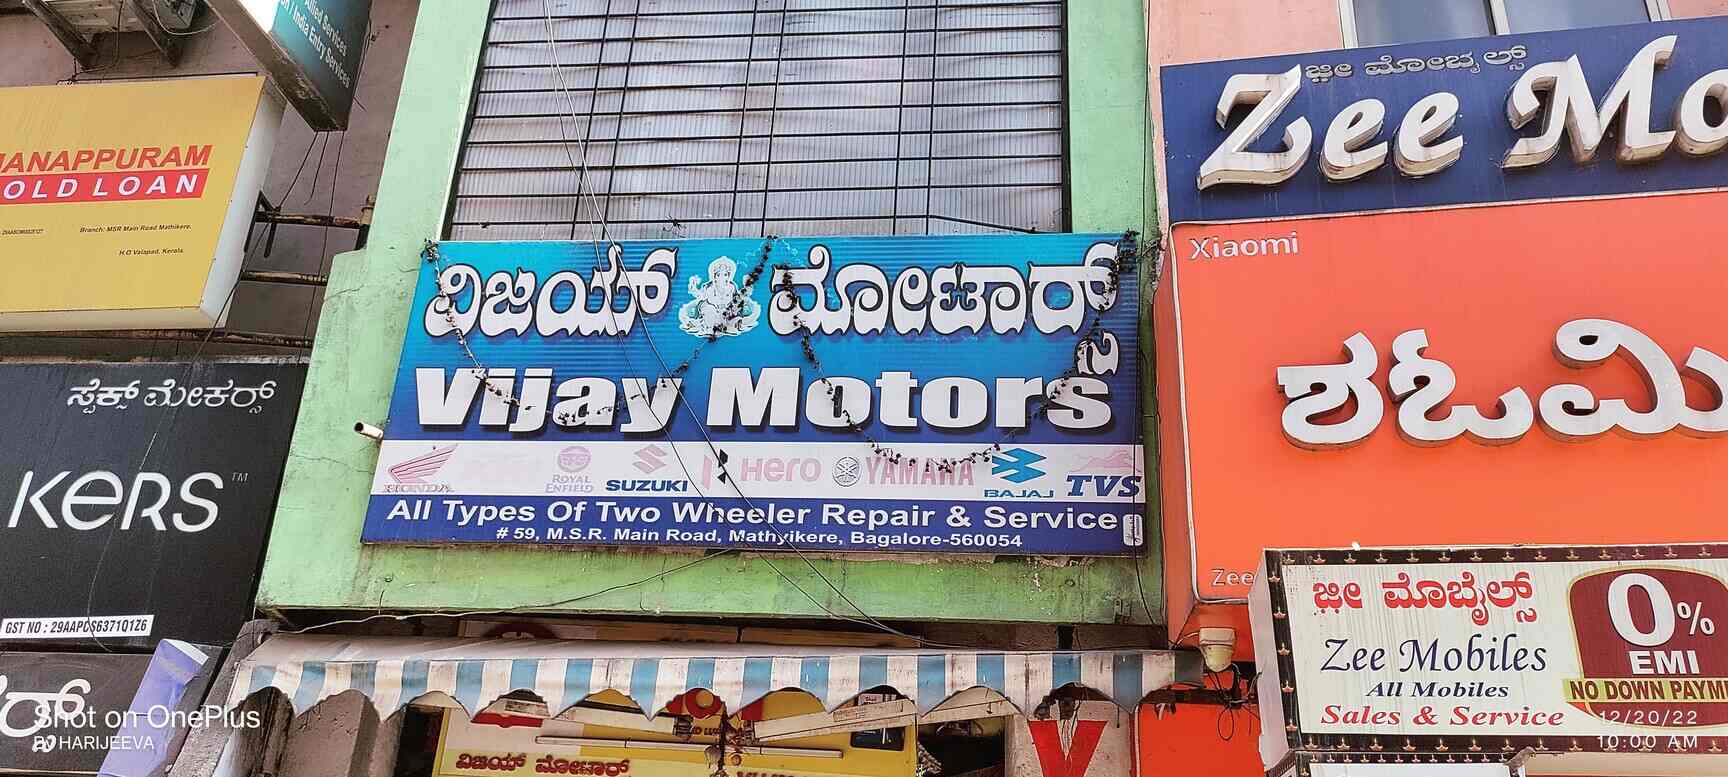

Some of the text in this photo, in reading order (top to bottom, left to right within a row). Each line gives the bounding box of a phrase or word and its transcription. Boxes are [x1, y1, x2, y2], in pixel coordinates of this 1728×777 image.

[322, 14, 347, 56] Services
[293, 5, 309, 37] India
[309, 26, 326, 60] Entry
[325, 47, 351, 89] Services
[1198, 64, 1463, 191] Zee
[93, 174, 199, 197] LOAN
[140, 223, 158, 231] Road
[1190, 231, 1299, 260] Xiaomi
[425, 244, 679, 338] ವಿಜಯ್
[416, 366, 1114, 433] Vijay Motors
[865, 456, 976, 486] YAMAHA
[605, 479, 688, 493] SUZUKI
[984, 488, 1054, 499] BAJAJ
[1066, 474, 1142, 497] TVS
[387, 499, 1118, 532] All Types Of Two Wheeler Repair & Service
[496, 528, 508, 539] #
[513, 527, 540, 541] 59,
[546, 528, 607, 540] M.S.R.
[614, 529, 661, 541] Main
[666, 529, 722, 544] Road,
[850, 532, 1022, 549] Bagalore-560054
[1211, 568, 1254, 587] Zee
[5, 621, 25, 634] GST
[27, 621, 42, 634] NO
[1321, 632, 1547, 673] Zee Mobiles
[1629, 650, 1700, 675] EMI
[1366, 681, 1509, 698] All Mobiles
[1570, 680, 1598, 699] NO
[1604, 680, 1665, 699] DOWN
[1320, 704, 1564, 727] Sales & Service
